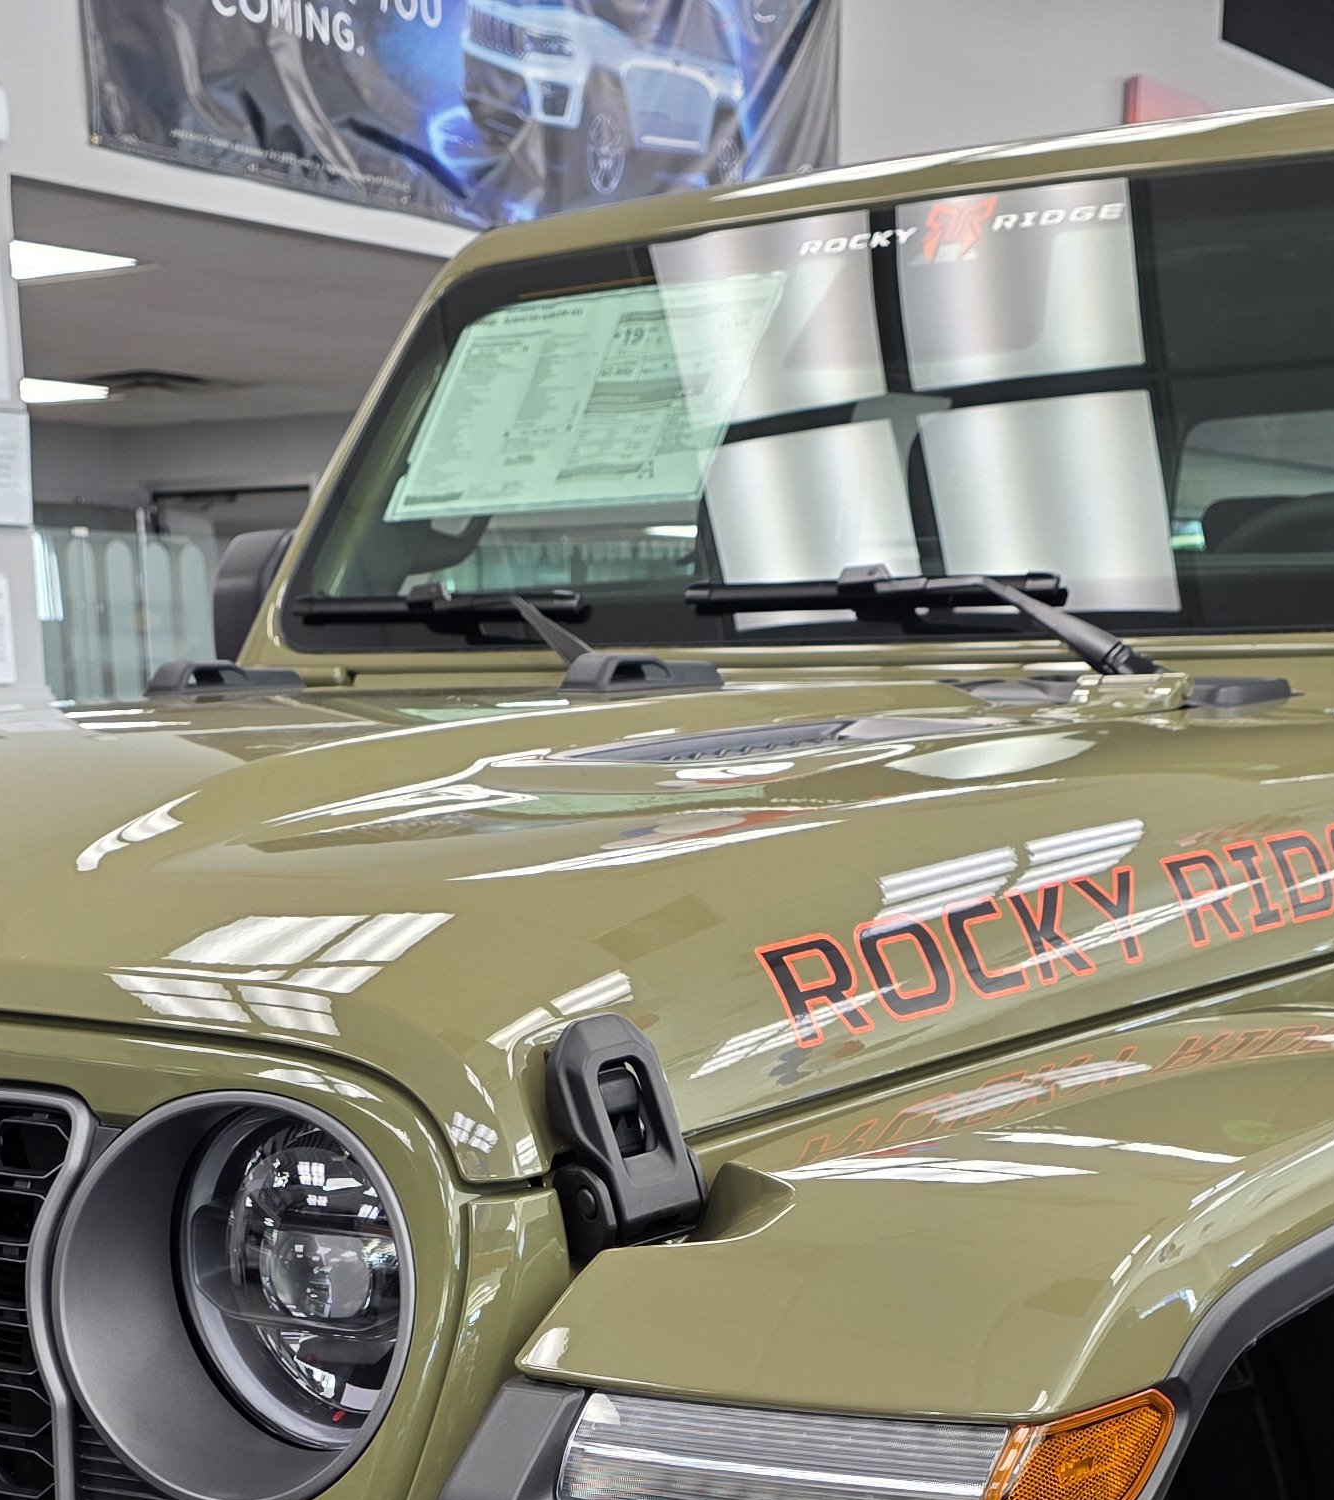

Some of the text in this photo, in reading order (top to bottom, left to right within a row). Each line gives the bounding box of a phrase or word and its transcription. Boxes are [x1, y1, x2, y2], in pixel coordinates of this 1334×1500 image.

[799, 226, 919, 257] ROCKY
[991, 202, 1127, 232] RIDGE
[754, 867, 1144, 1049] ROCKY
